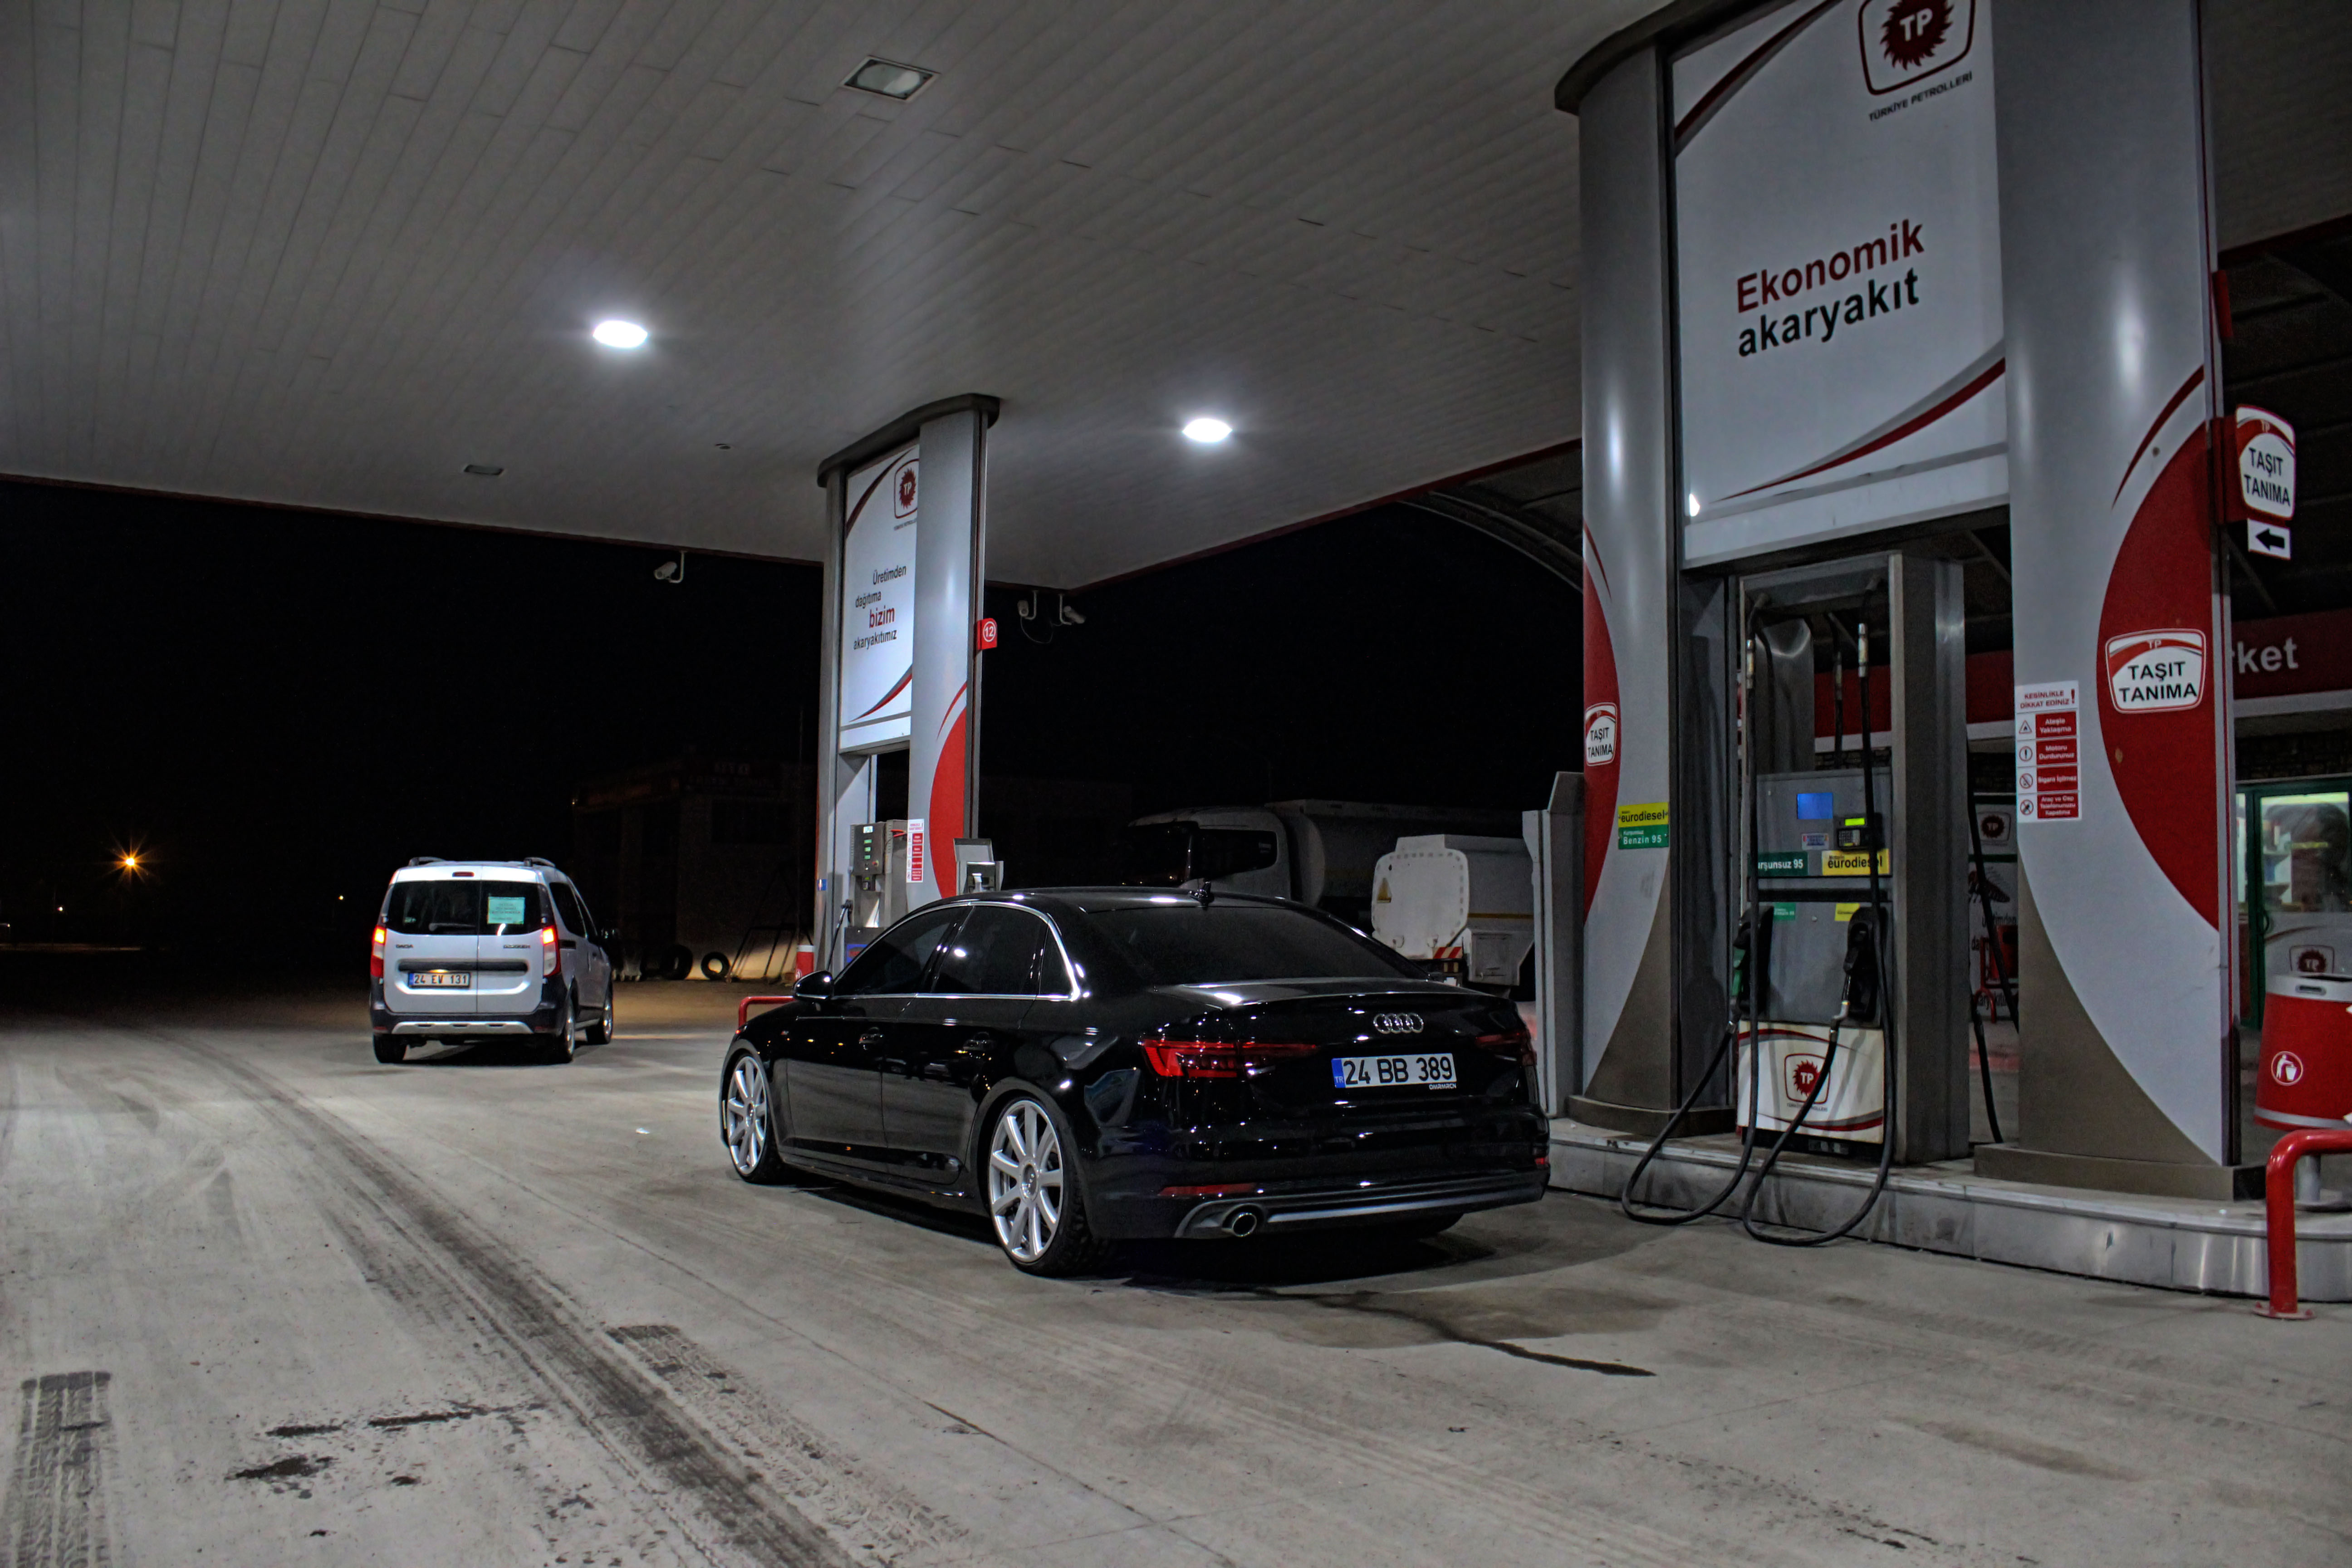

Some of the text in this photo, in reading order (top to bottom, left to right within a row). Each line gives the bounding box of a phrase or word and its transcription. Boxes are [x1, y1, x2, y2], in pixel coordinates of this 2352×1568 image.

[1900, 8, 1933, 42] TP
[1869, 71, 1973, 122] TÜRKİYE PETROLLERİ
[1737, 219, 1924, 313] Ekonomik
[1739, 267, 1919, 357] akaryakıt
[2249, 447, 2283, 478] TAŞIT
[904, 481, 912, 495] TP
[2244, 475, 2290, 507] TANIMA
[873, 565, 906, 585] Üretimden
[855, 591, 882, 609] dağıtıma
[869, 605, 896, 628] bizim
[853, 629, 897, 650] akaryakıtımız
[985, 626, 994, 637] 12
[2232, 637, 2299, 674] ket
[2127, 661, 2186, 681] TAŞIT
[2119, 682, 2197, 702] TANIMA
[2020, 701, 2043, 709] DİKKAT
[2046, 698, 2070, 706] EDİNİZ
[1590, 727, 1610, 742] TAŞIT
[1588, 744, 1613, 758] TANIMA
[1622, 809, 1664, 822] eurodiesel
[1623, 834, 1662, 845] Benzin 95
[1758, 858, 1804, 871] rşunsuz 95
[1828, 855, 1882, 868] eurodiesl
[415, 975, 466, 984] 24 EV 131
[1343, 1056, 1452, 1085] 24 BB 389
[1800, 1072, 1814, 1085] TP
